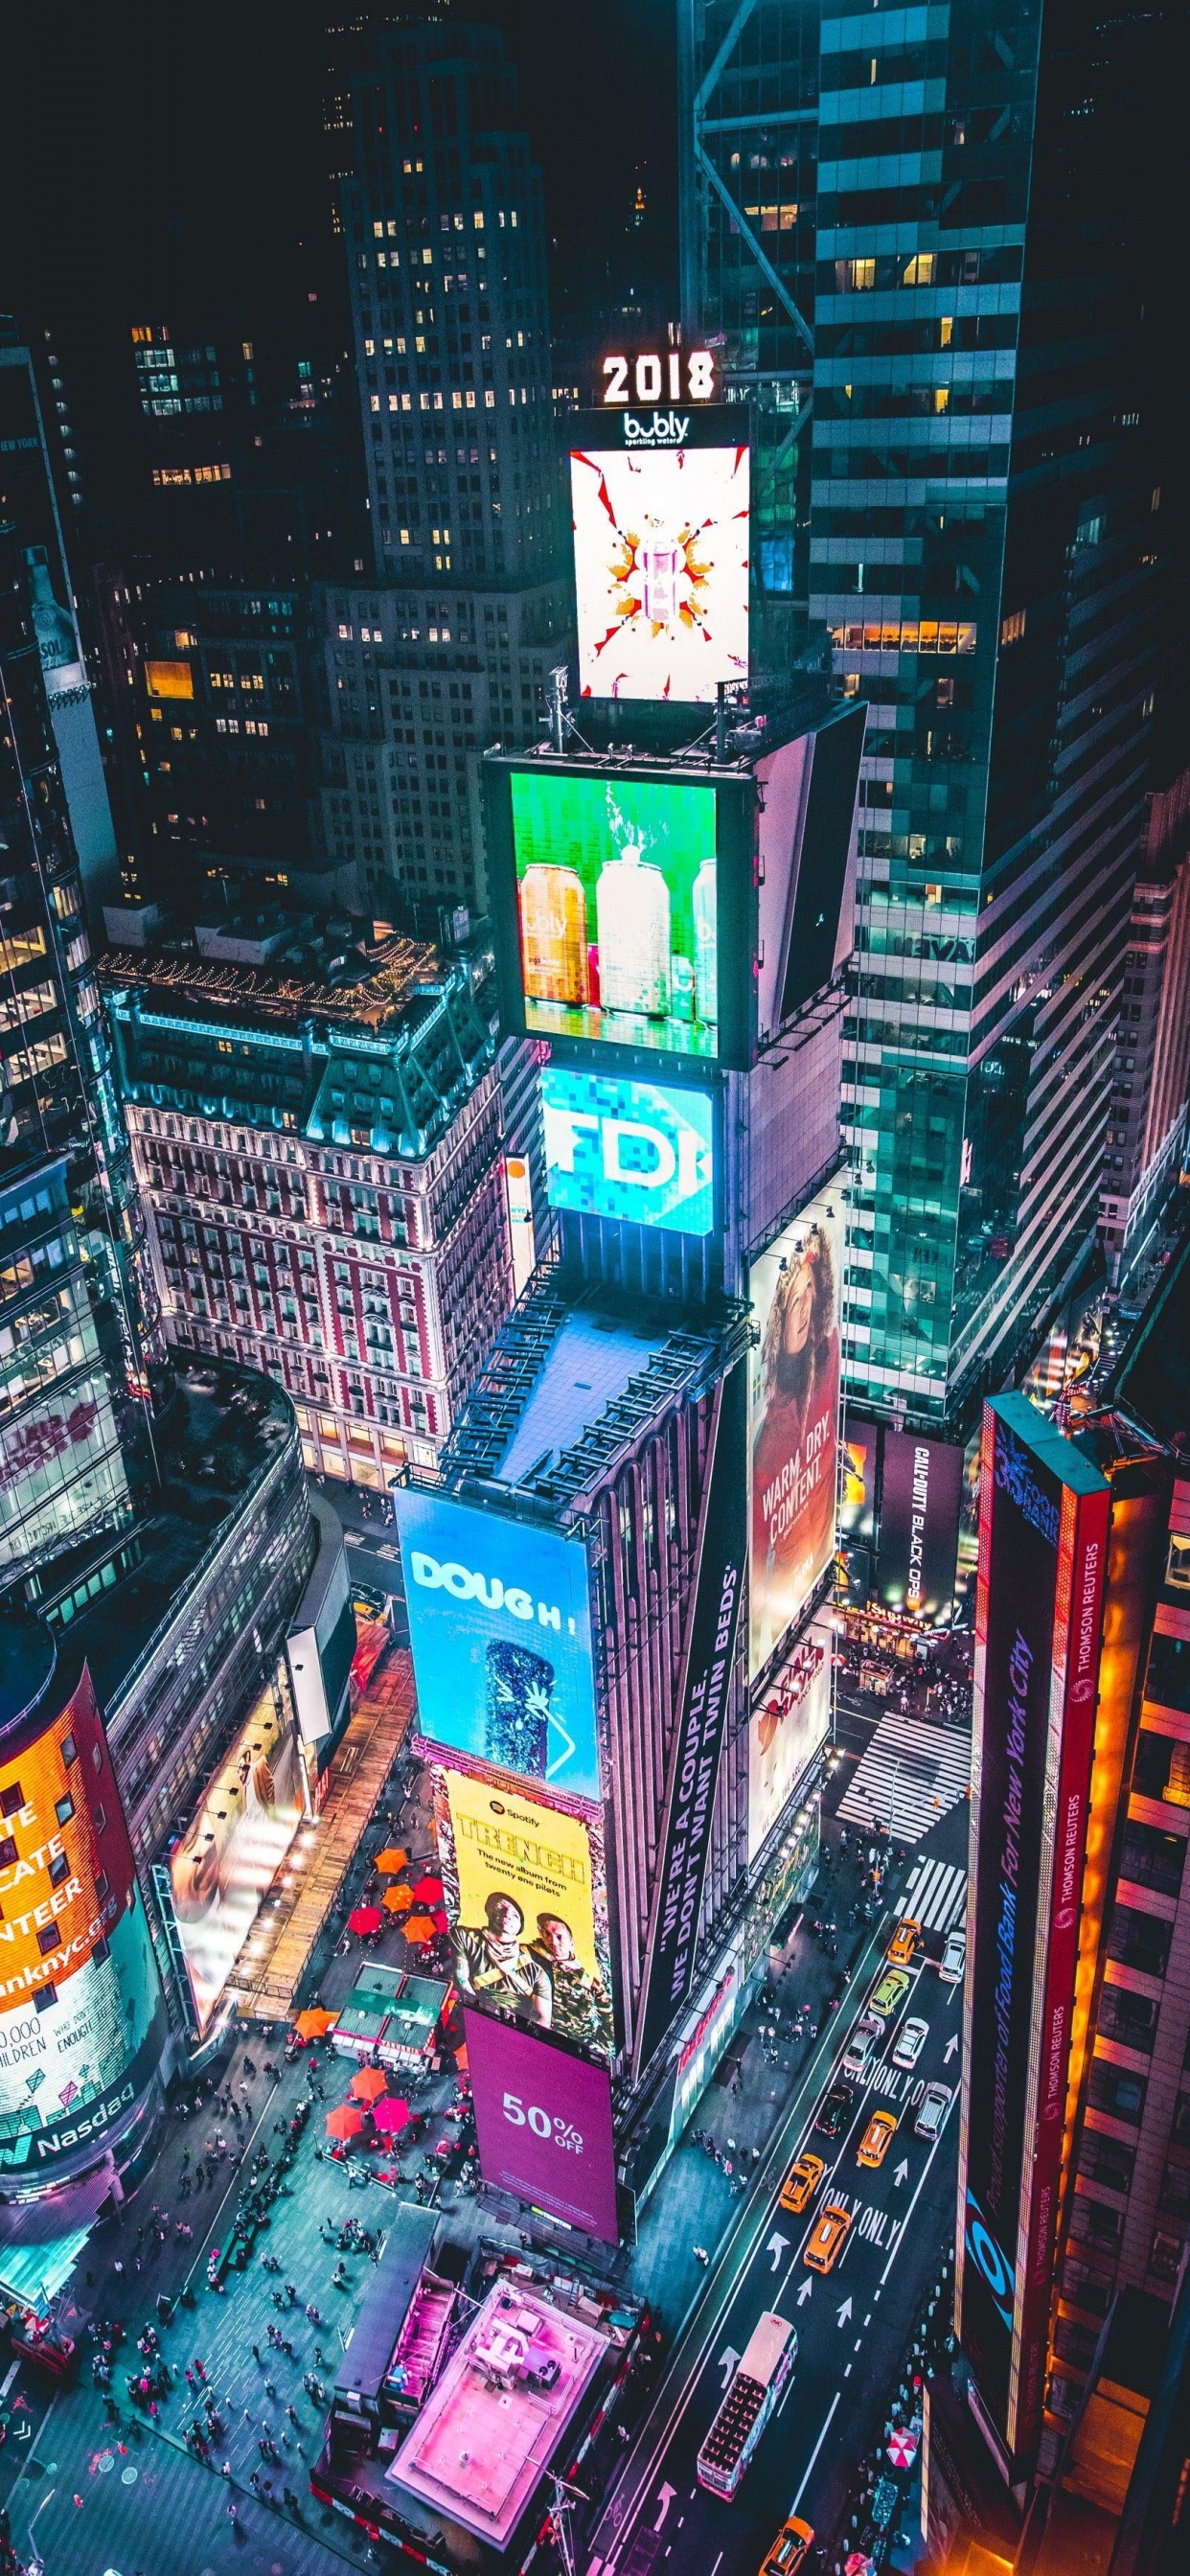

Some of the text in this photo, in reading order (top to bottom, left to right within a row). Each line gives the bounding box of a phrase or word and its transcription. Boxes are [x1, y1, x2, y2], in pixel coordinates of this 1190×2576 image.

[604, 351, 715, 402] 2018
[625, 438, 655, 447] sparkling
[762, 1449, 803, 1522] WARM.
[806, 1411, 831, 1464] DRY.
[769, 1453, 822, 1546] CONTENT.
[909, 1515, 925, 1567] BLACK
[907, 1569, 921, 1599] OPS
[1078, 1543, 1098, 1672] THOMSON REUTERS
[1010, 1628, 1033, 1697] City
[678, 1668, 708, 1804] COUPLE.
[702, 1659, 725, 1747] TWIN
[1006, 1695, 1027, 1767] York
[507, 1808, 539, 1828] Spotify
[675, 1806, 690, 1830] A
[690, 1751, 714, 1848] WANT
[1003, 1764, 1022, 1839] New
[456, 1811, 585, 1885] TRENCH
[477, 1849, 567, 1891] The new album from
[485, 1862, 515, 1879] twenty
[1001, 1834, 1019, 1888] For
[1062, 1794, 1080, 1904] THOMSON REUTERS
[677, 1852, 700, 1945] DON'T
[998, 1882, 1017, 1957] Bank
[671, 1947, 688, 2002] WE
[995, 1943, 1013, 2020] Food
[57, 2020, 94, 2053] ENOUGH
[995, 2004, 1009, 2047] of
[1048, 2006, 1064, 2099] THOMSON REUTERS
[874, 2065, 914, 2103] ONLY
[36, 2082, 136, 2157] Nasdaq
[555, 2135, 584, 2155] OFF
[858, 2207, 901, 2250] ONLY
[1037, 2186, 1051, 2266] THOMSON REUTERS
